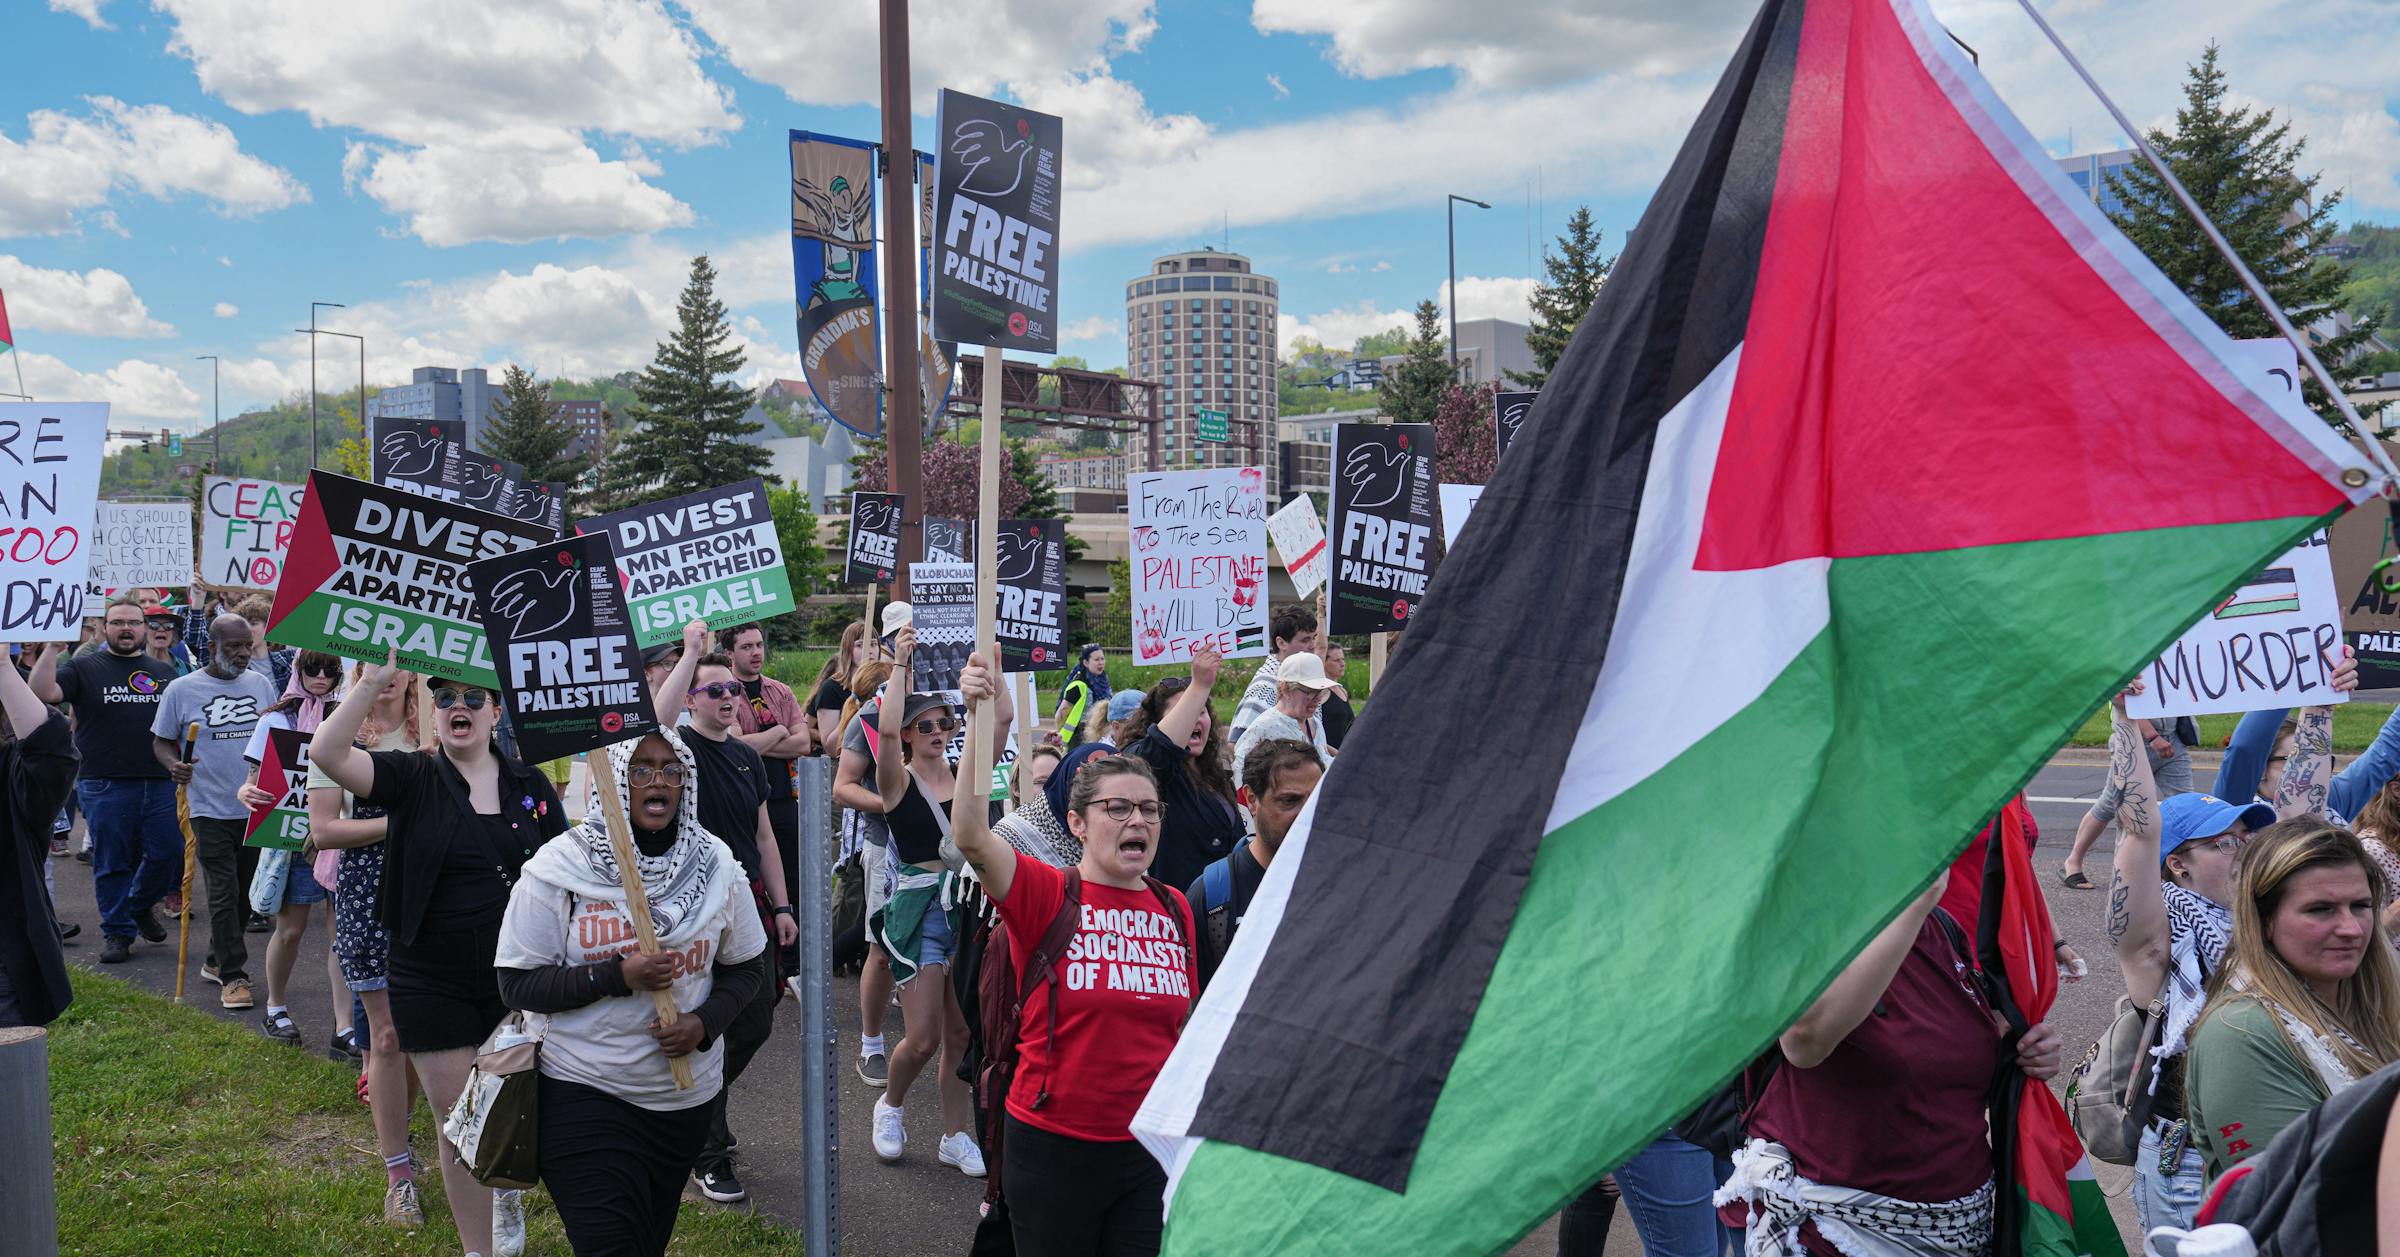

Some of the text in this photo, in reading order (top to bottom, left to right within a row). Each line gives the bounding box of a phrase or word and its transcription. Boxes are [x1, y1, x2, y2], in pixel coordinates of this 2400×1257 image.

[944, 193, 1053, 283] FREE
[943, 250, 1051, 313] PALESTINE
[805, 308, 871, 370] GRANDMA'S
[1028, 320, 1042, 334] DSA
[0, 418, 68, 466] RE
[208, 481, 305, 520] CEAS
[1141, 478, 1186, 520] From
[1187, 485, 1222, 520] The
[135, 509, 187, 524] SHOULD
[618, 491, 755, 549] DIVEST
[107, 525, 187, 546] COGNIZE
[225, 518, 296, 552] FIR
[854, 529, 898, 558] FREE
[1133, 525, 1248, 551] To The Sea
[1340, 510, 1431, 571] FREE
[106, 546, 189, 566] LESTINE
[344, 542, 475, 594] MN FRO
[626, 529, 756, 576] MN FROM
[853, 550, 896, 569] PALESTINE
[110, 568, 190, 584] A COUNTRY
[226, 556, 285, 585] NO
[631, 547, 777, 599] APARTHEID
[914, 568, 974, 579] KLOBUCHAR
[1143, 555, 1264, 592] PALESTINE
[1339, 558, 1429, 596] PALESTINE
[2, 578, 83, 630] DEAD
[331, 570, 483, 620] APARTHE
[636, 577, 777, 633] ISRAEL
[912, 584, 975, 596] WE SAY NO T
[929, 595, 941, 603] AID
[943, 595, 954, 603] TO
[956, 594, 975, 602] ISRAE
[1216, 597, 1256, 628] Be
[1408, 603, 1418, 613] DS
[323, 602, 496, 671] ISRAEL
[650, 610, 757, 641] ANTIWAMITTEE.ORG
[995, 620, 1061, 645] ALESTINE
[2358, 633, 2400, 651] PALE
[508, 635, 630, 689] FREE
[2154, 622, 2336, 709] MURDER
[103, 693, 164, 704] POWERFU
[110, 685, 129, 694] AM
[517, 682, 641, 713] PALESTINE
[202, 697, 260, 726] BE
[624, 712, 640, 723] DSA
[215, 732, 228, 740] THE
[578, 915, 634, 949] Uni
[1066, 932, 1187, 971] SOCIALISTS
[1066, 962, 1191, 998] OF AMERIC
